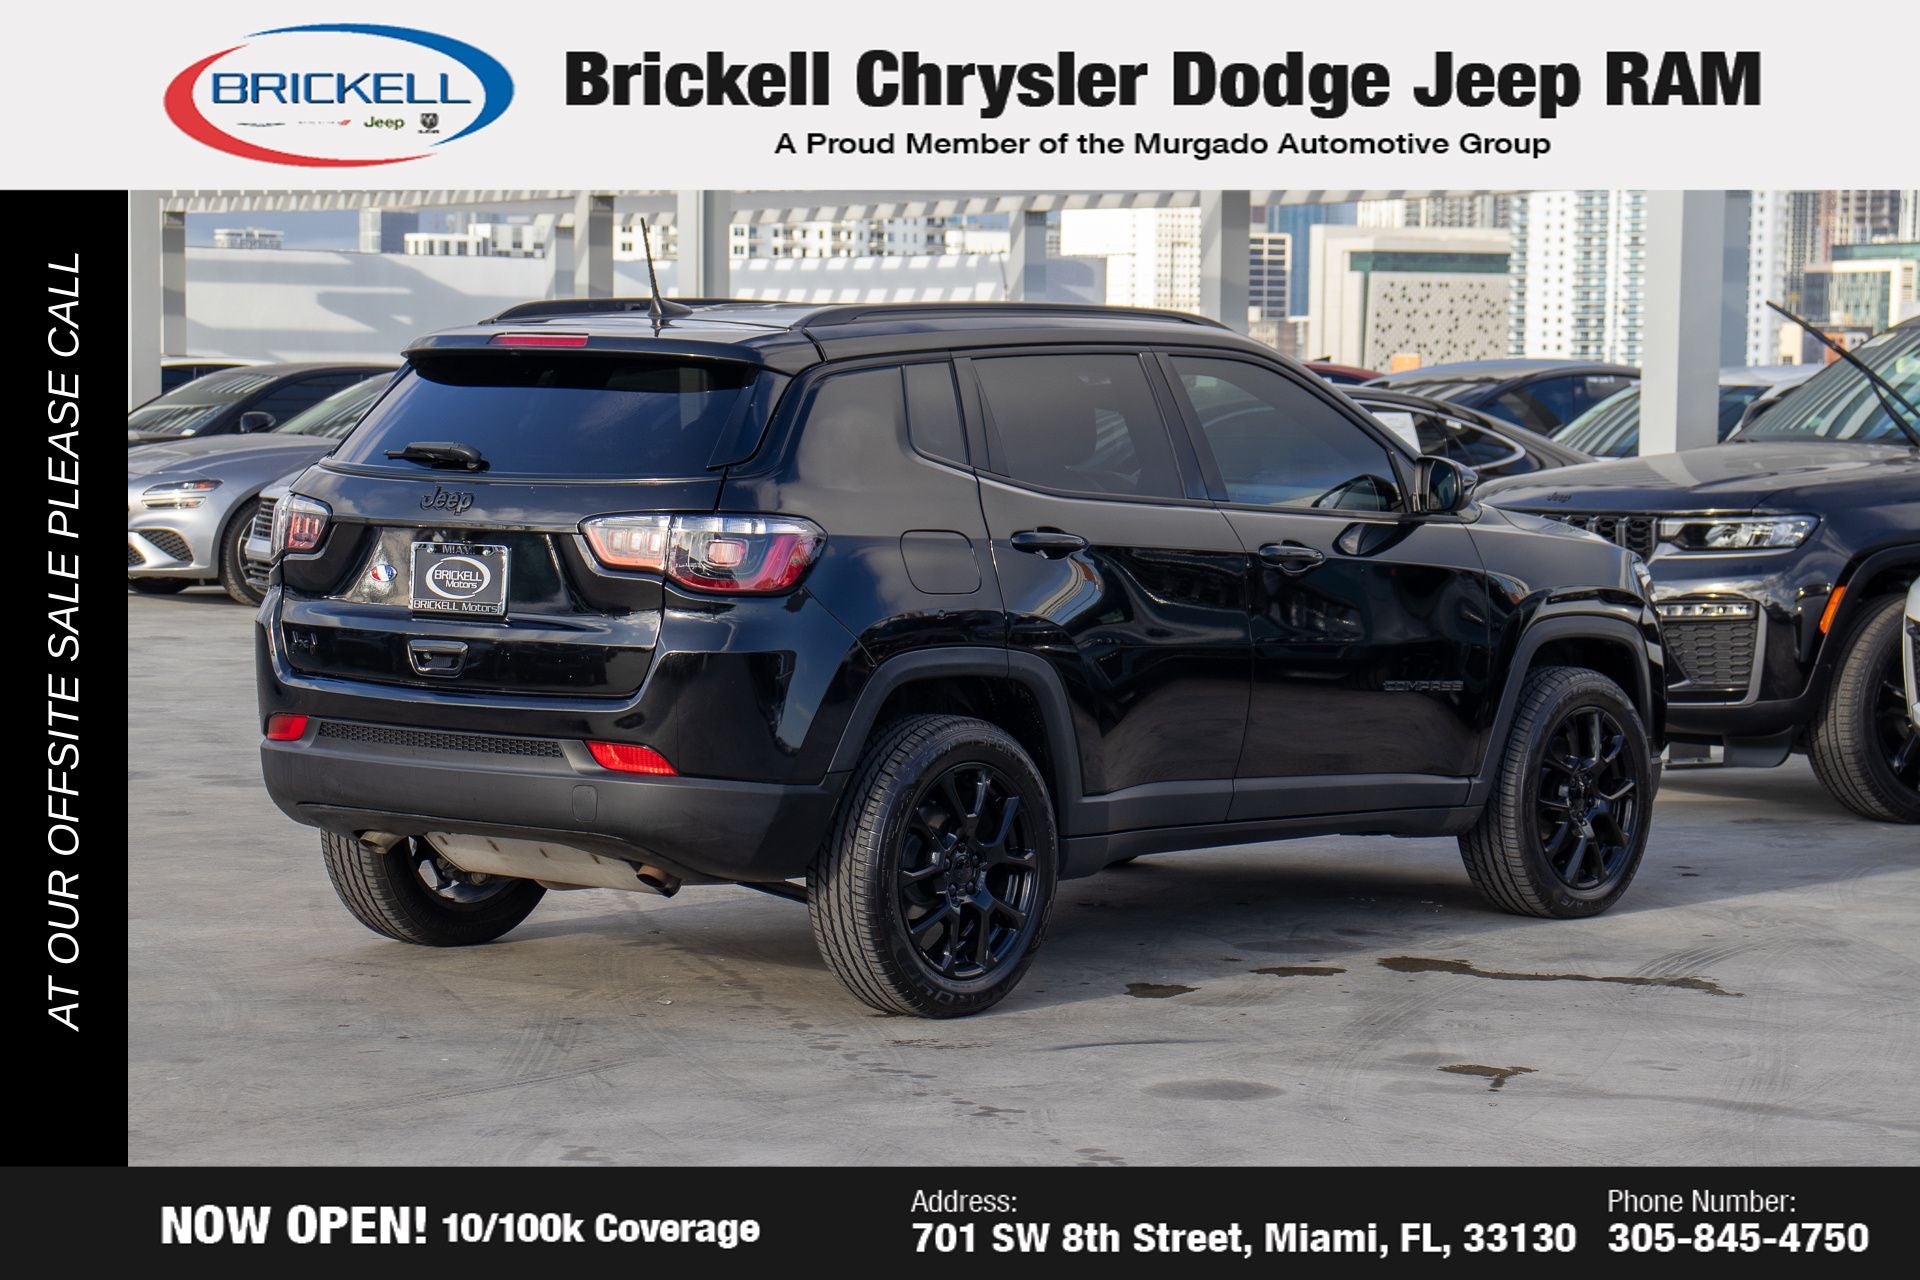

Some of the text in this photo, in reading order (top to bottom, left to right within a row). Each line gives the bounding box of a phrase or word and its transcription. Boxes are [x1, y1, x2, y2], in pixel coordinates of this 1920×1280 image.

[420, 486, 475, 514] Jeep
[434, 569, 482, 582] BRICKELL
[445, 580, 478, 589] Motors
[413, 600, 498, 613] BRICKELL Motors
